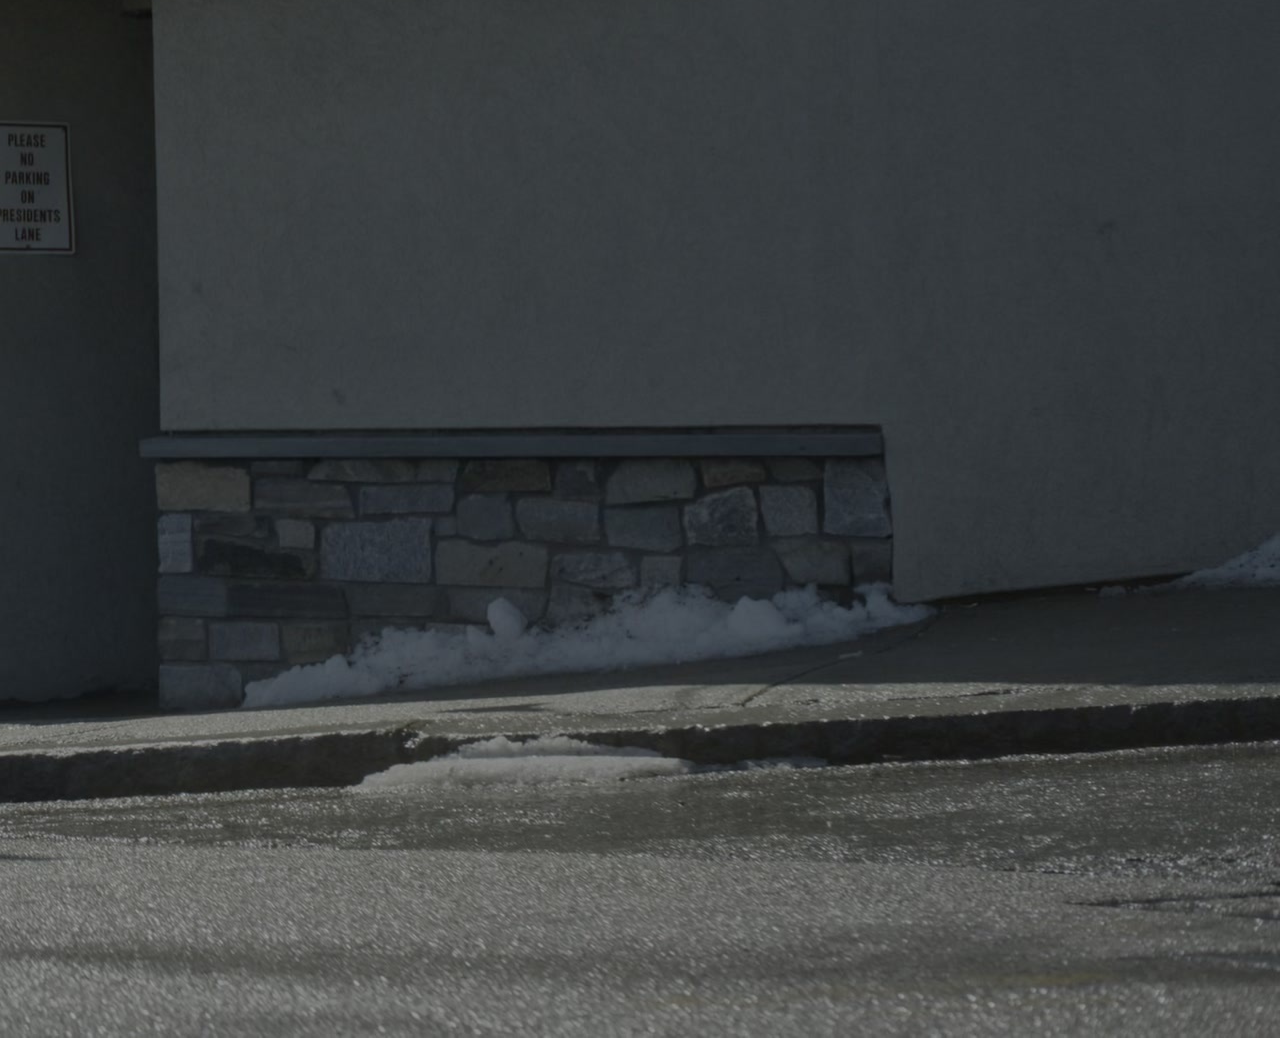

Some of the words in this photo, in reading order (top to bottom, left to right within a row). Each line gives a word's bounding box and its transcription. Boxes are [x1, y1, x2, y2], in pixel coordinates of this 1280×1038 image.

[7, 133, 46, 148] PLEASE
[20, 152, 34, 166] NO
[4, 171, 51, 186] PARKING
[20, 189, 35, 204] ON
[14, 227, 42, 242] LANE
